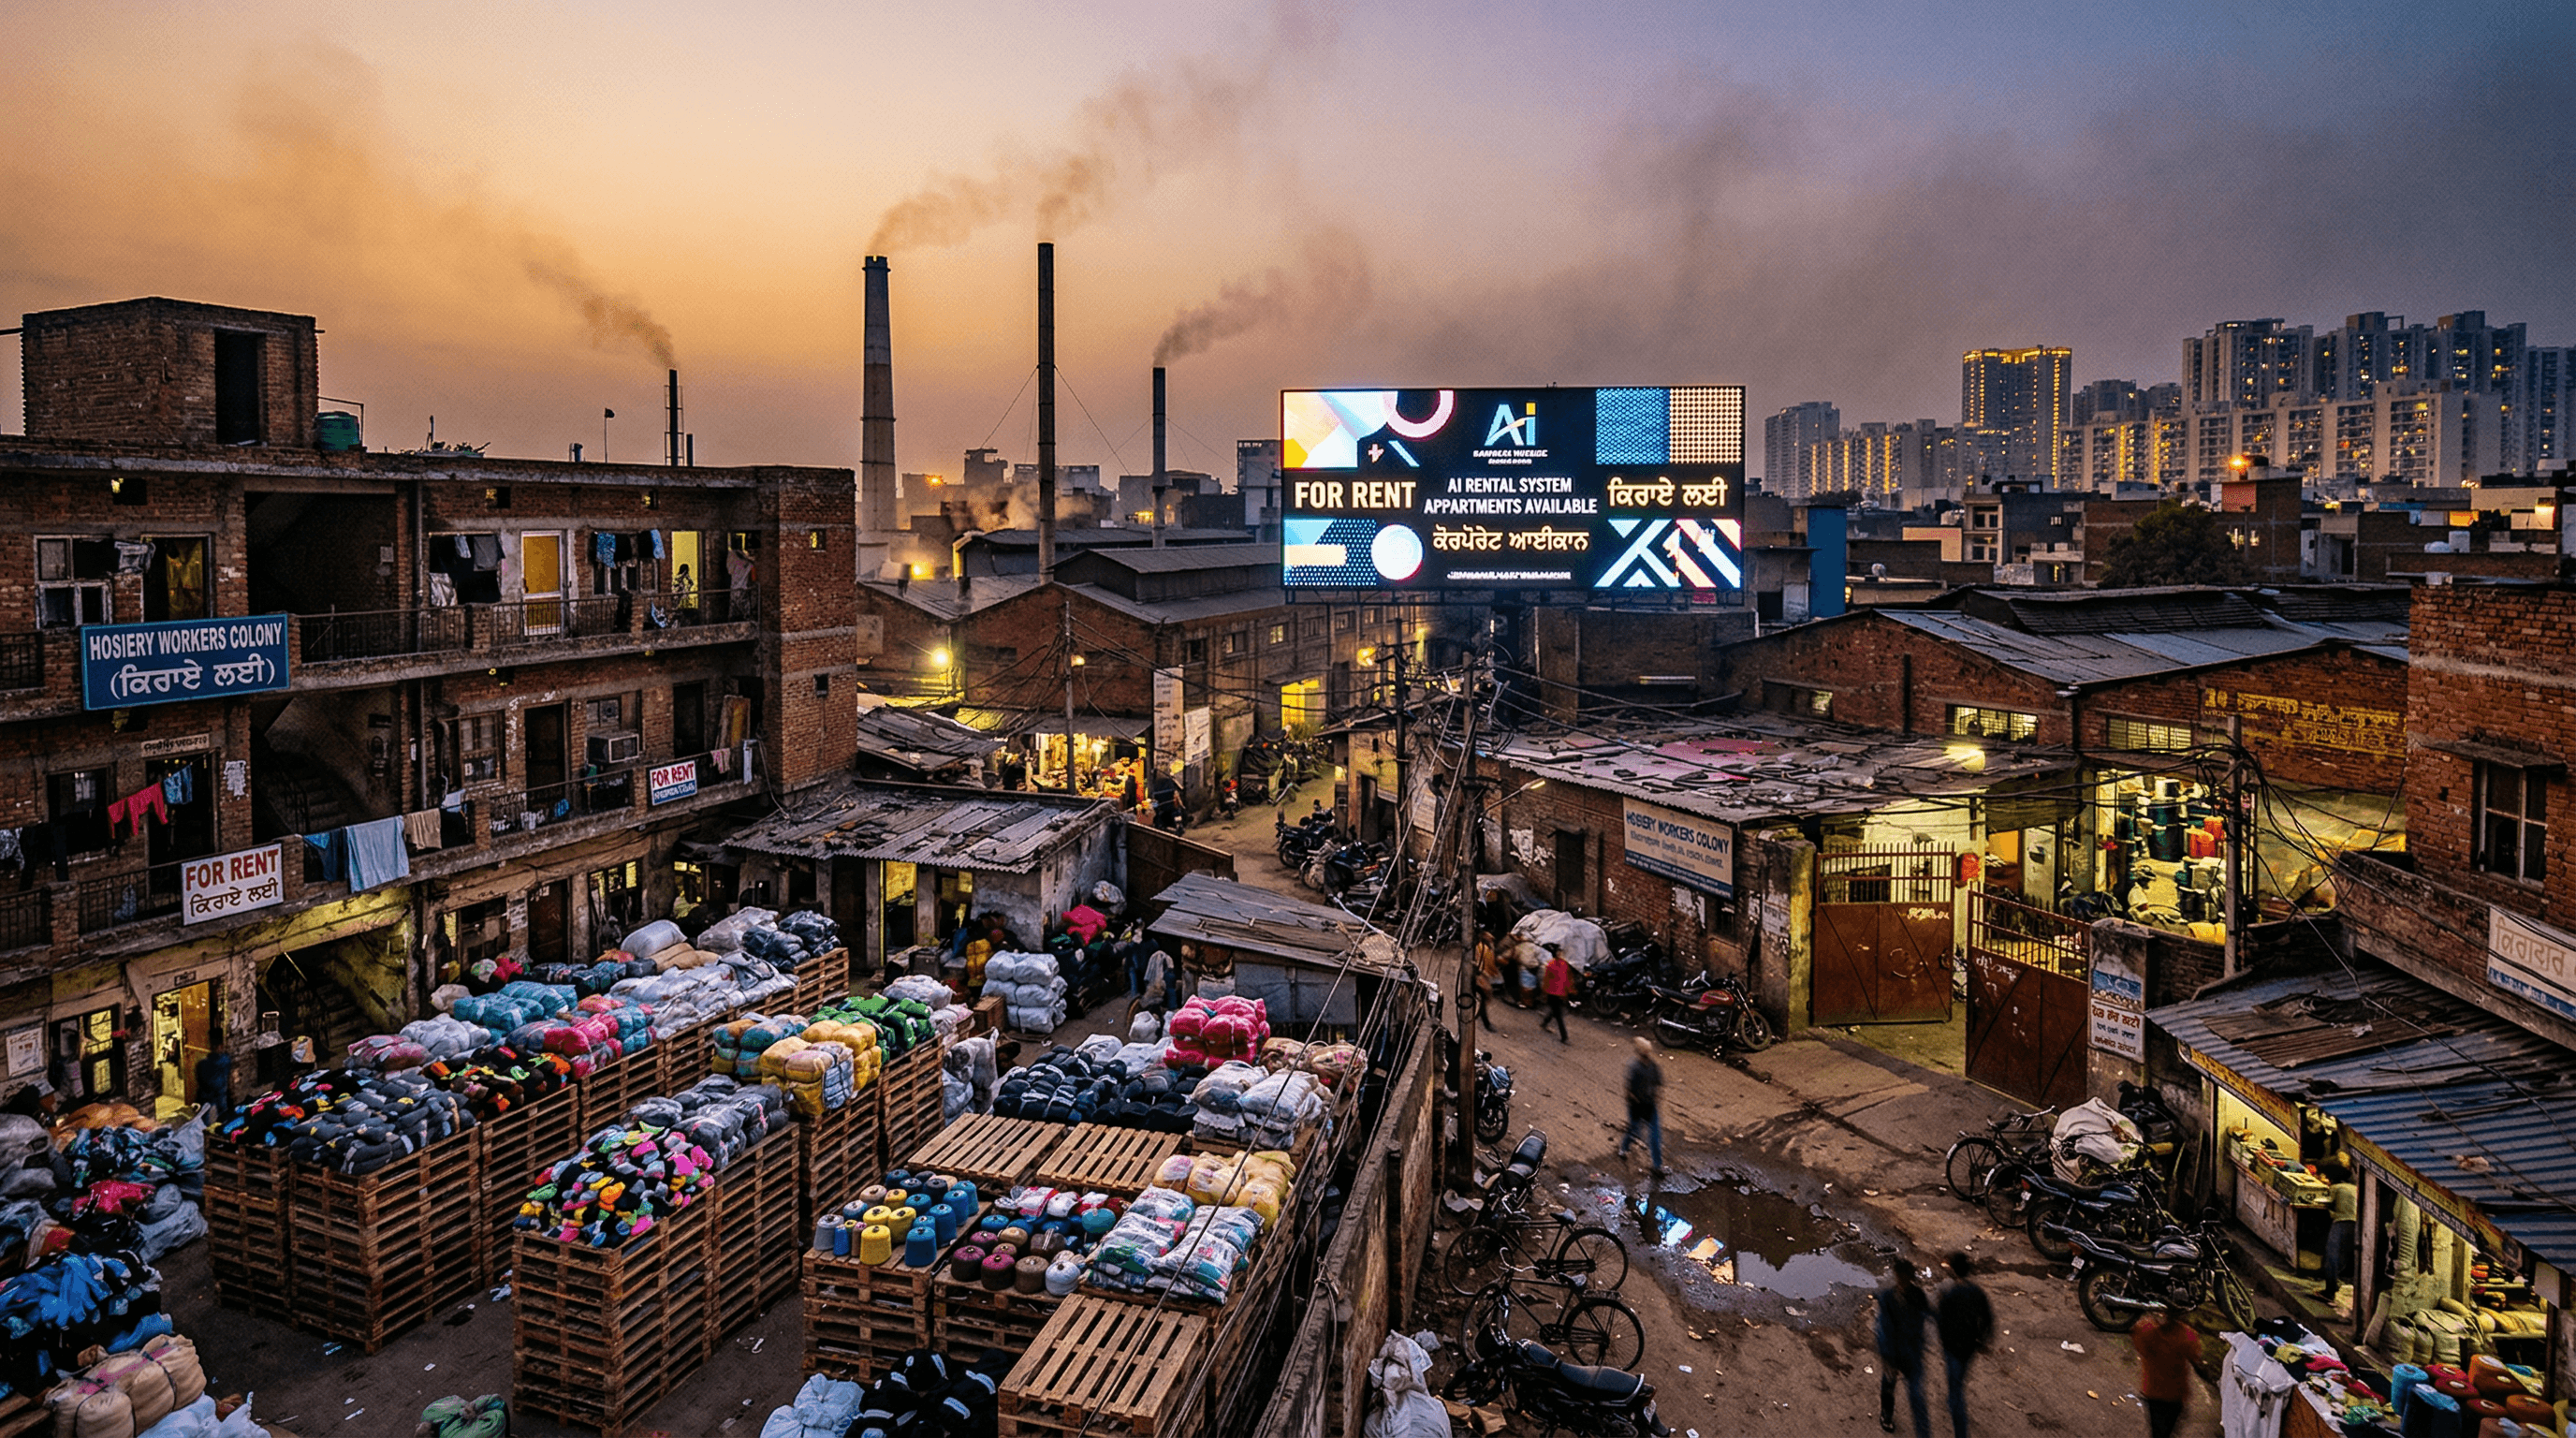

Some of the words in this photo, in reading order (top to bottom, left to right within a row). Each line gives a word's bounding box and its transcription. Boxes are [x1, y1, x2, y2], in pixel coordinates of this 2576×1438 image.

[1295, 480, 1344, 508] FOR
[1352, 481, 1416, 508] RENT
[1447, 477, 1462, 492] AI
[1465, 477, 1516, 492] RENTAL
[1519, 477, 1573, 492] SYSTEM
[1607, 477, 1676, 506] ਕਿਰਾਏ
[1681, 476, 1729, 506] ਲਈ
[1424, 498, 1522, 514] APPARTMENTS
[1524, 498, 1598, 514] AVAILABLE
[1432, 523, 1503, 550] ਕੋਰਪੋਰੇਟ
[1508, 524, 1589, 550] ਆਈਕਾਨ
[90, 632, 154, 661] HOSIERY
[157, 626, 227, 655] WORKERS
[229, 623, 283, 649] COLONY
[110, 658, 203, 700] (ਕਿਰਾਏ
[212, 653, 275, 686] ਲਈ)
[651, 769, 670, 787] FOR
[671, 763, 694, 783] RENT
[1696, 831, 1730, 854] COLONY
[185, 860, 226, 891] FOR
[230, 848, 279, 882] RENT
[190, 886, 242, 917] ਕਿਰਾਏ
[246, 876, 279, 902] ਲਈ
